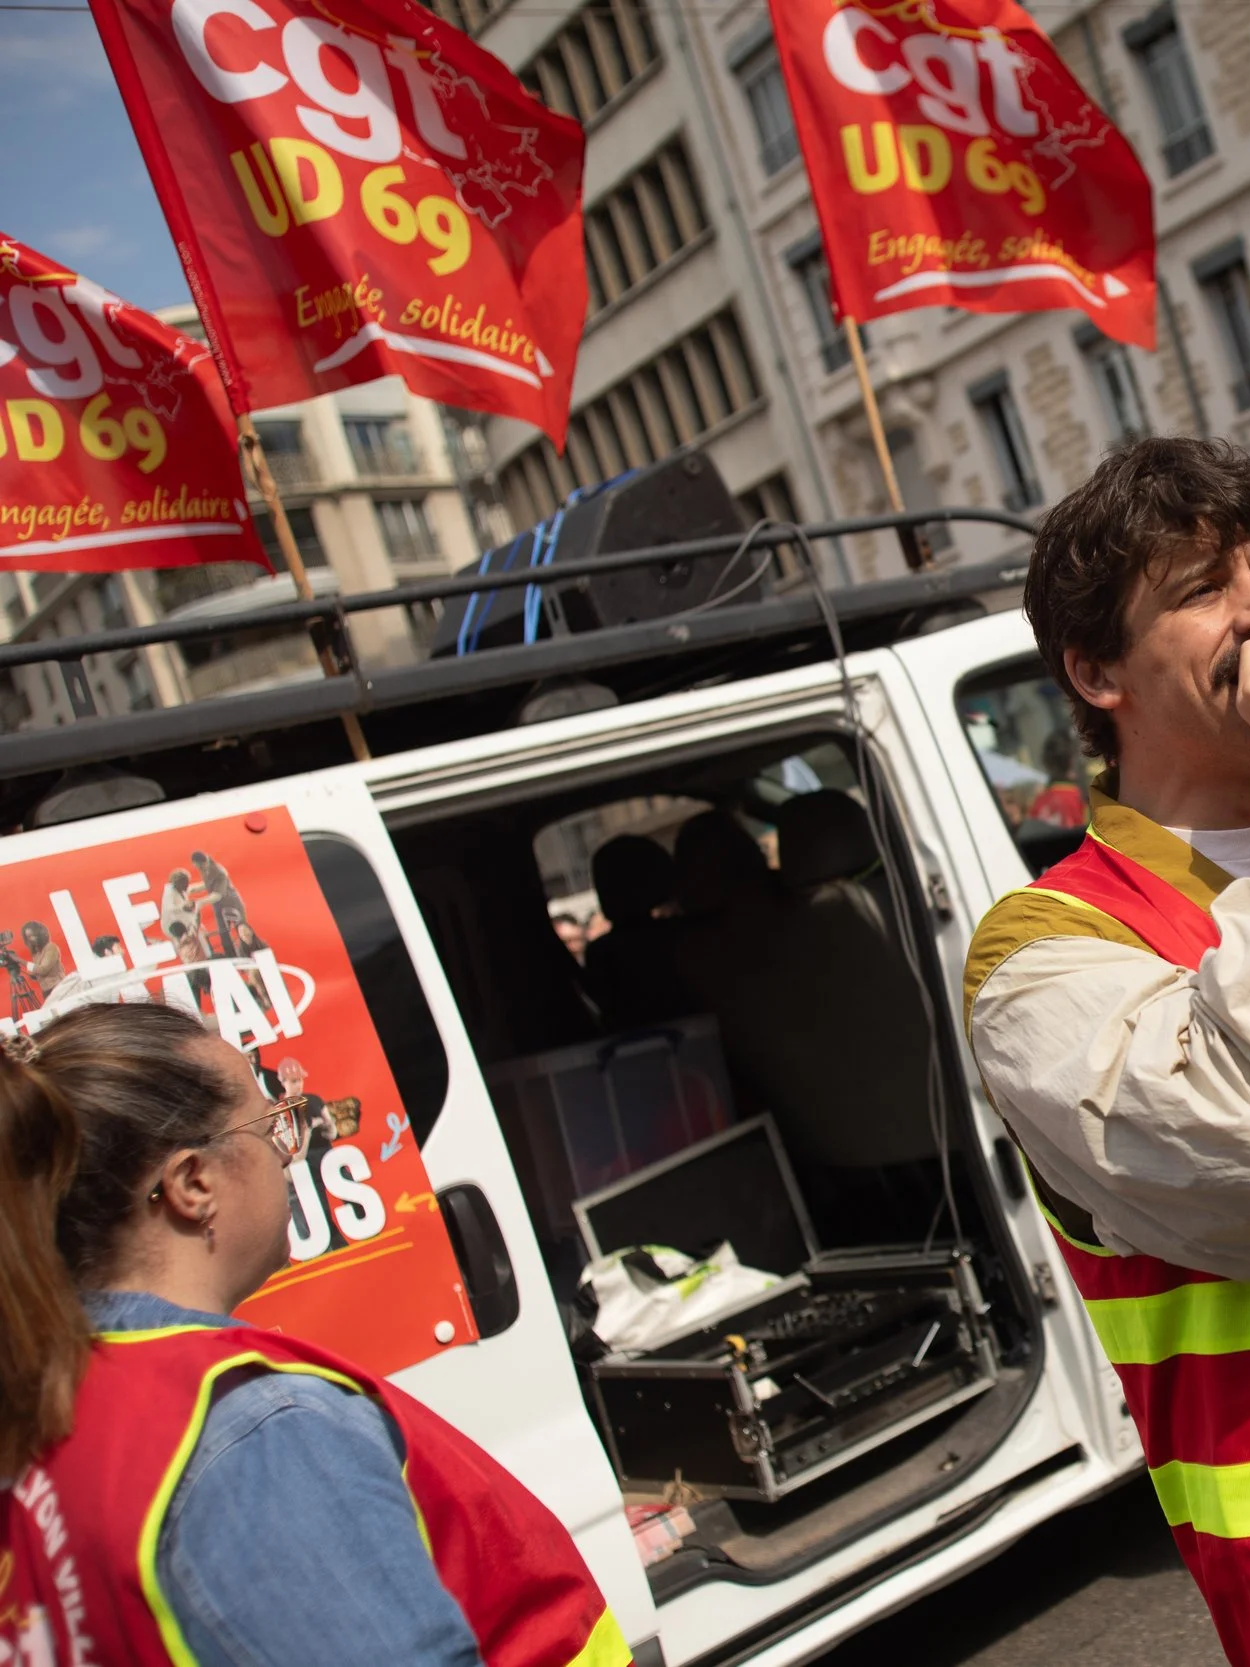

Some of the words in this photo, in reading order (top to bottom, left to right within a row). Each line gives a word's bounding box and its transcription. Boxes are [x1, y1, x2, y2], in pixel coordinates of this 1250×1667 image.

[171, 0, 467, 164] cgt
[823, 6, 1039, 137] cgt
[230, 137, 344, 237] UD
[361, 165, 471, 276] 69
[841, 121, 952, 194] UD
[966, 137, 1047, 214] 69
[0, 276, 143, 400] gt
[0, 398, 65, 462] D
[79, 393, 167, 474] 69
[120, 483, 230, 524] solidaire
[49, 871, 177, 982] LE
[287, 1144, 386, 1262] US
[13, 1463, 68, 1560] LYON
[55, 1556, 103, 1667] VILL
